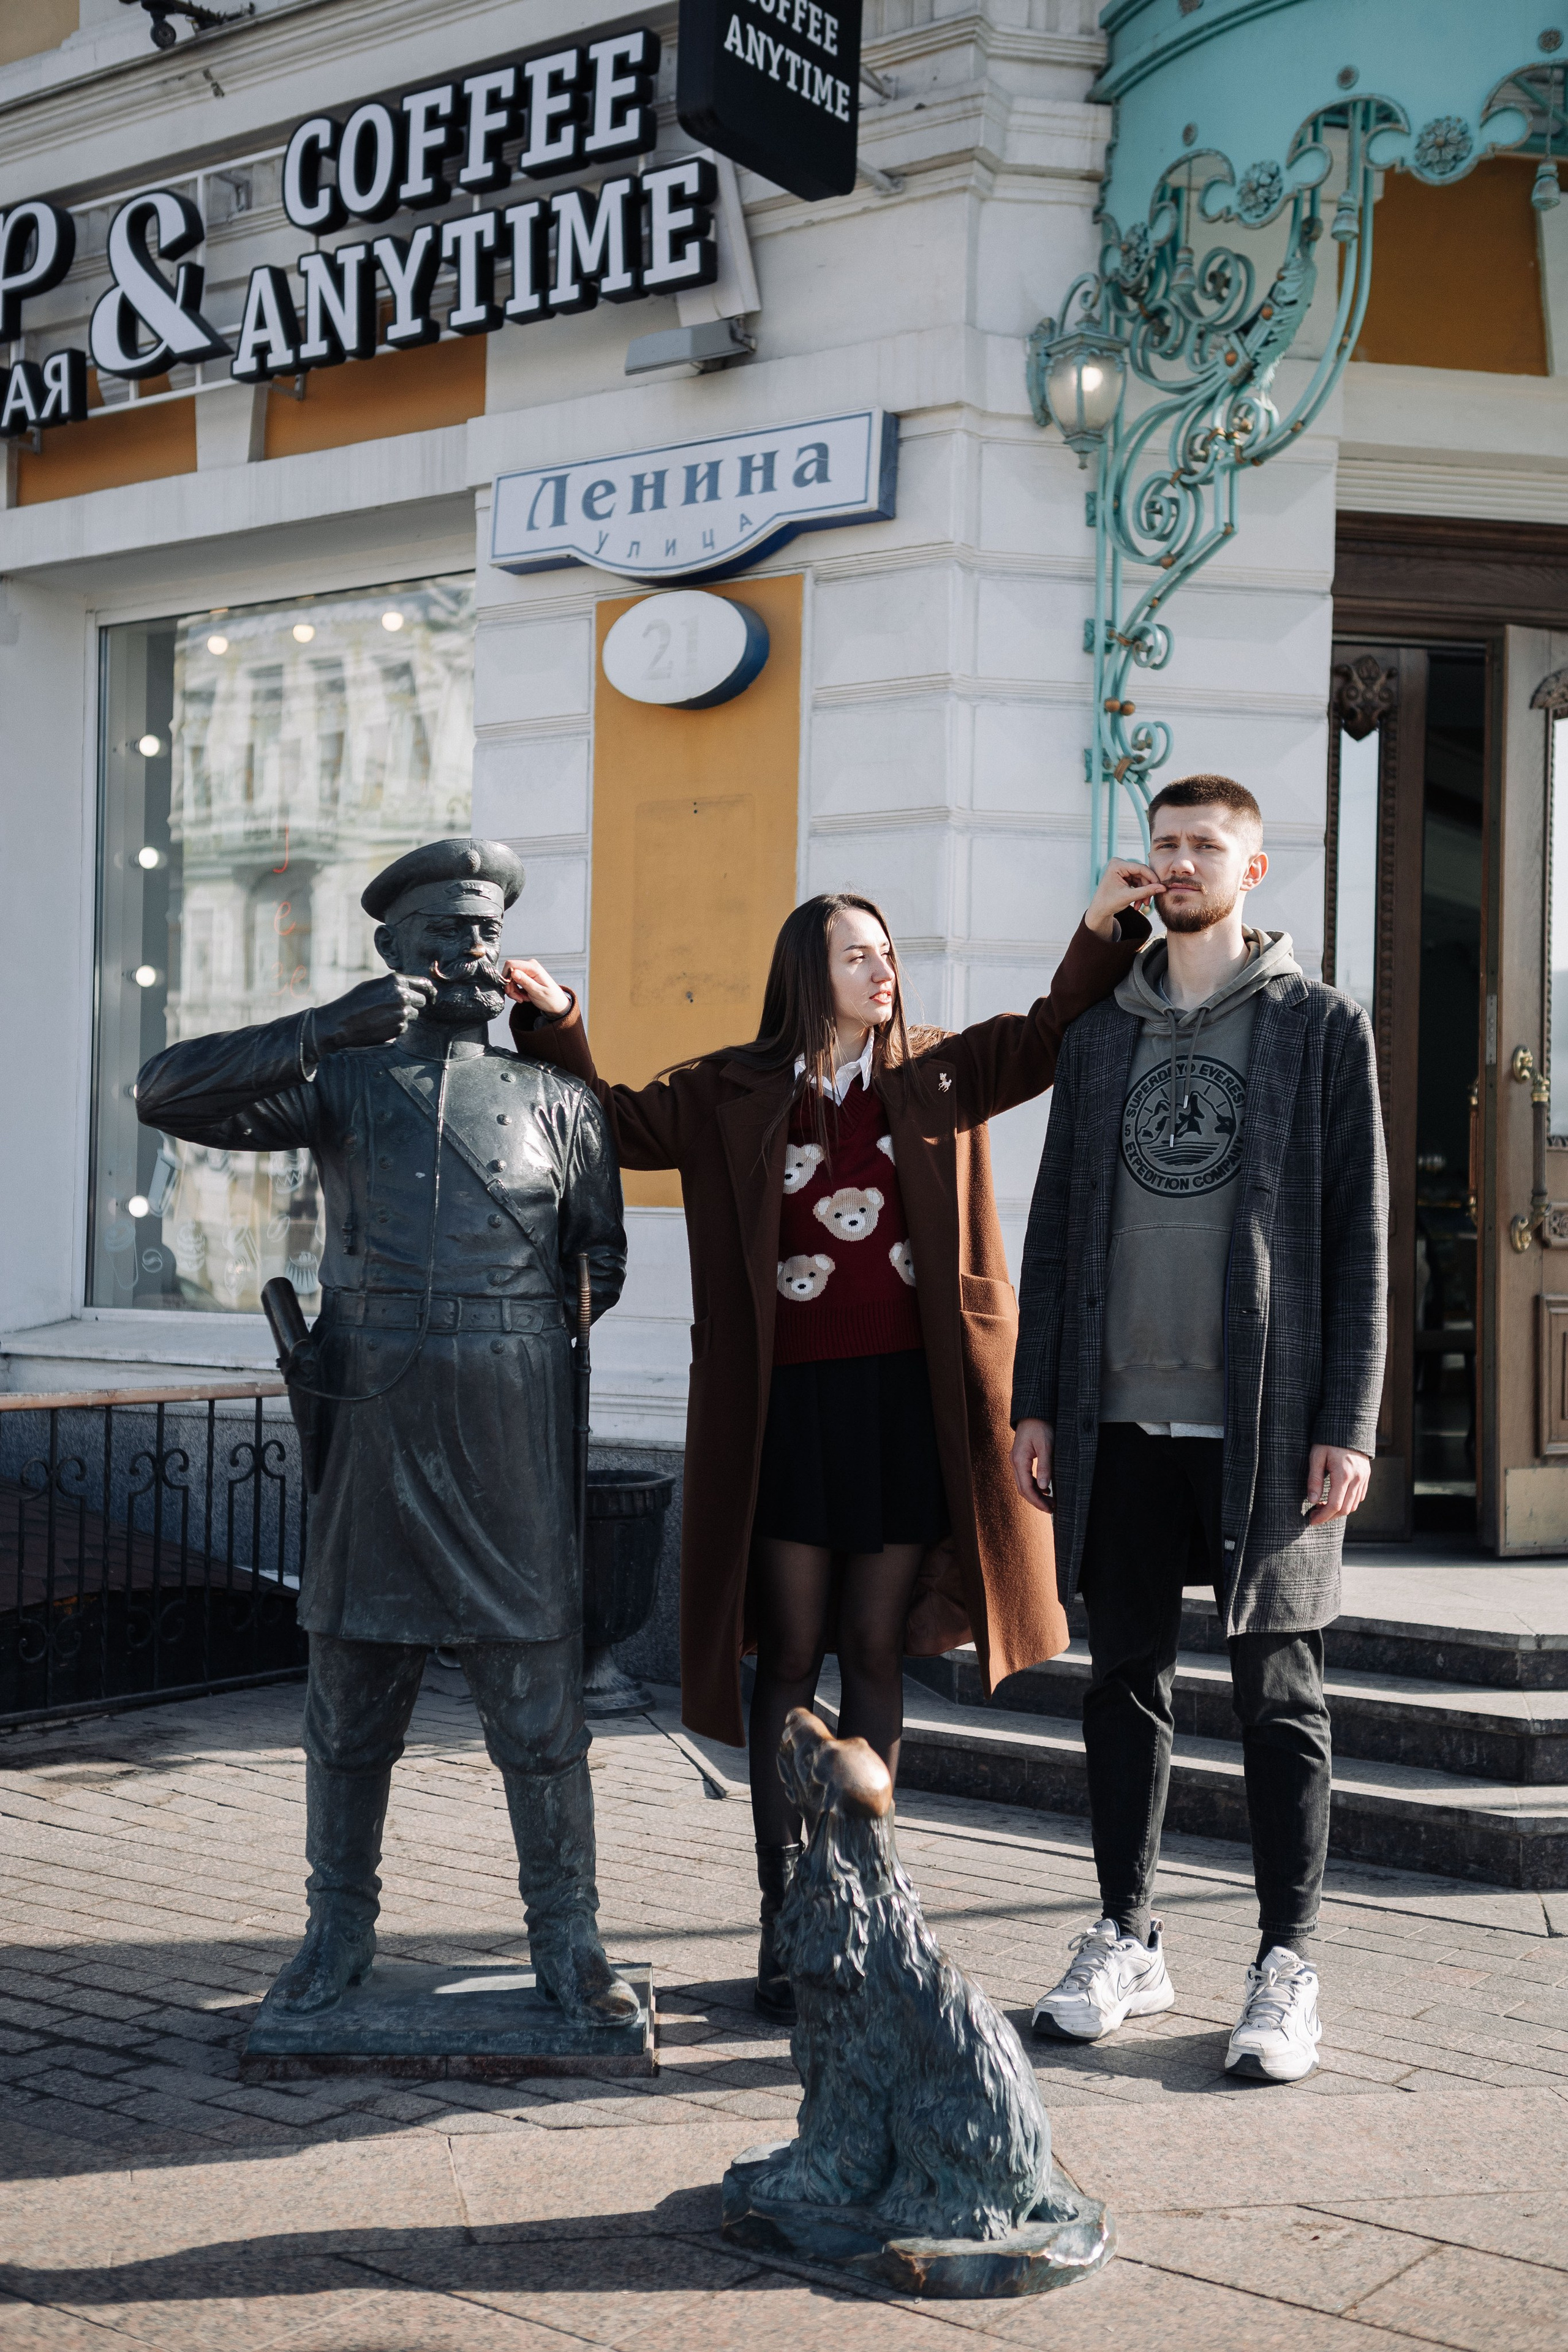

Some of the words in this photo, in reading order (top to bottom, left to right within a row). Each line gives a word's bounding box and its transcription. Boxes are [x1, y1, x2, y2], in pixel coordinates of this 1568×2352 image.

[723, 14, 850, 123] ANYTIME
[746, 0, 839, 56] FFEE
[285, 31, 646, 227] COFFEE
[91, 190, 212, 372] &
[233, 163, 701, 374] ANYTIME
[526, 441, 832, 531] Ленина
[641, 614, 699, 680] 21
[1126, 1142, 1189, 1190] EXPEDITION
[1193, 1136, 1243, 1189] COMPANY
